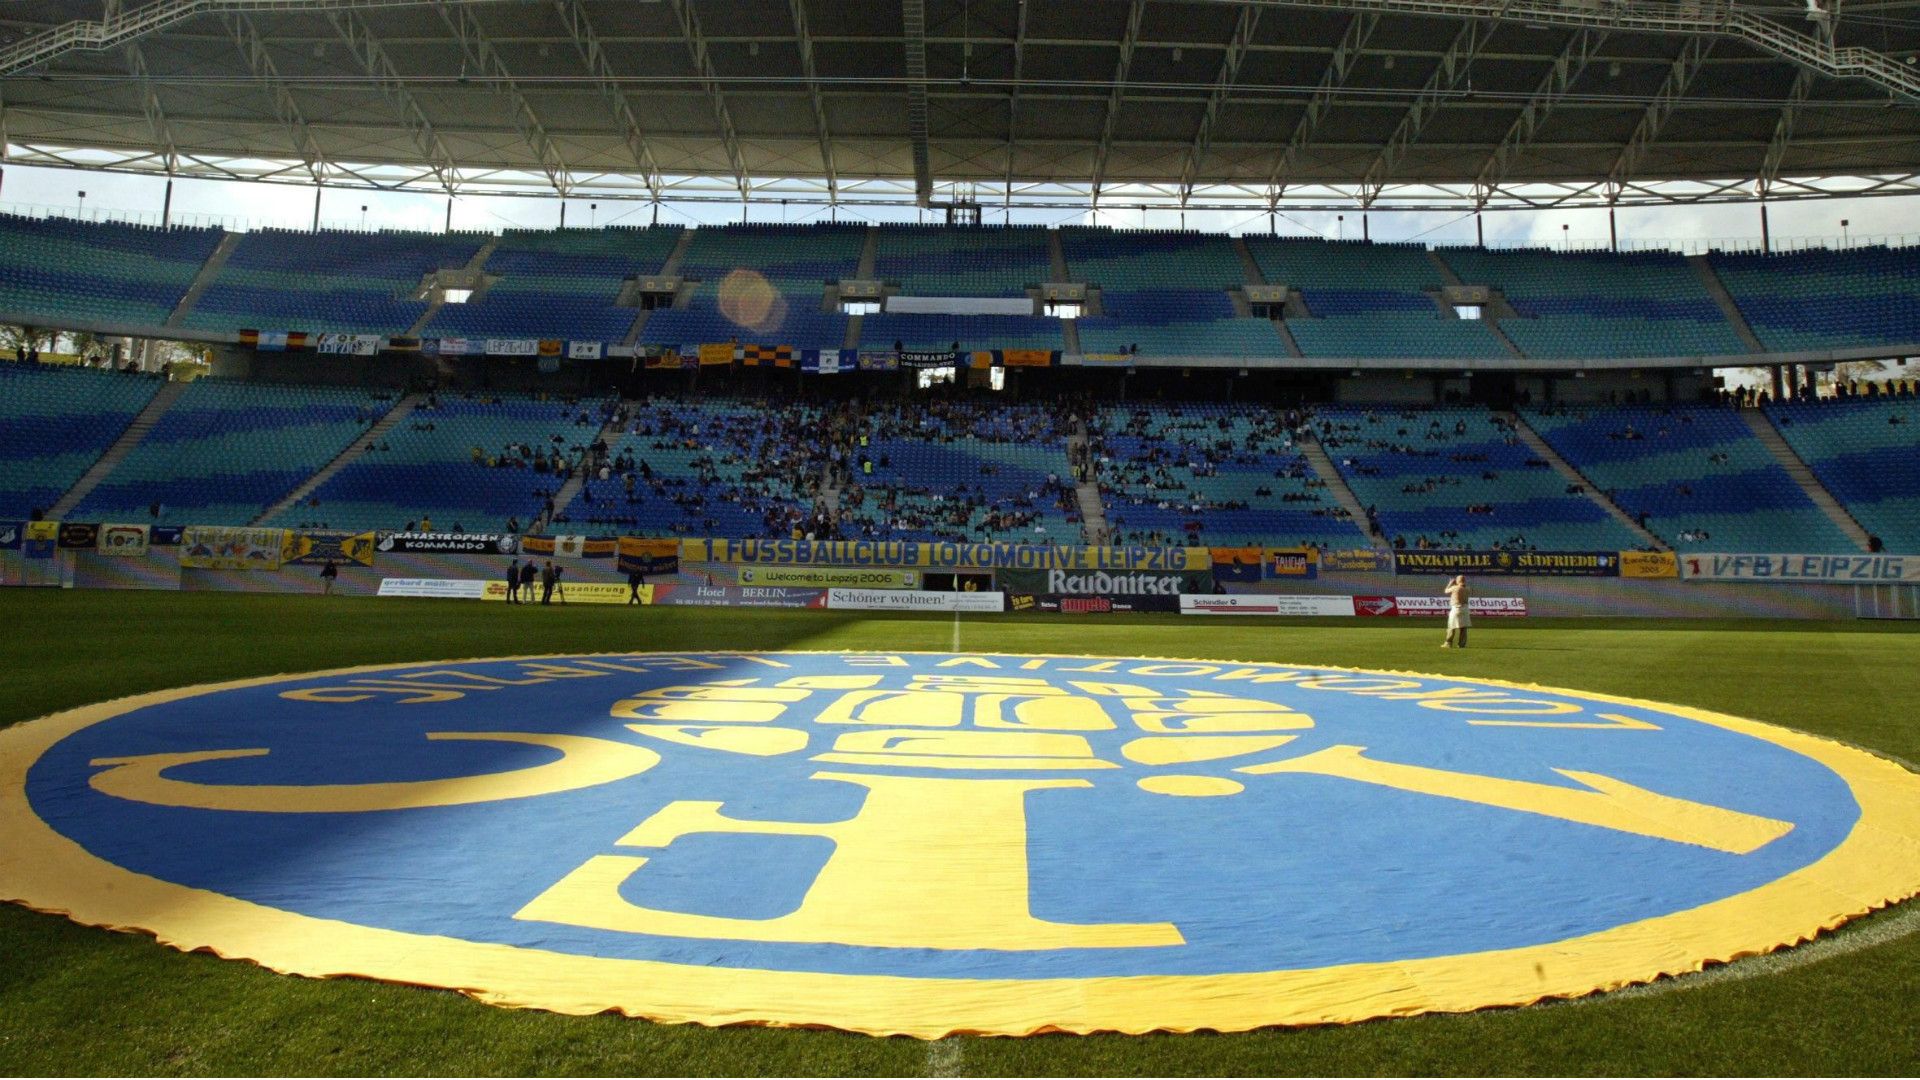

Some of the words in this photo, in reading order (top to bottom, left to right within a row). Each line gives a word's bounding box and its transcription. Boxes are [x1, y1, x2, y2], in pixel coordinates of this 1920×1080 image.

[900, 353, 955, 361] COMMANDO
[392, 532, 500, 542] KATASTROPHEN
[405, 542, 485, 550] KOMMANDO
[704, 540, 720, 562] 1.
[727, 539, 919, 566] FUSSBALLCLUB
[930, 543, 1088, 569] LOKOMOTIVE
[1098, 545, 1187, 570] LEIPZIG
[1397, 554, 1491, 567] TANZKAPELLE
[1713, 557, 1772, 577] VFB
[1781, 558, 1905, 580] LEIPZIG
[767, 573, 813, 583] Welcome
[814, 575, 824, 584] to
[827, 574, 859, 588] Leipzig
[861, 575, 893, 587] 2006
[1048, 570, 1182, 595] Reudnitzer
[697, 587, 726, 597] Hotel
[742, 588, 786, 598] BERLIN
[833, 592, 885, 605] Schöner
[891, 594, 945, 606] wohnen!
[278, 656, 790, 703] LEIPZIG
[840, 655, 1662, 730] LOKOMOTIVE
